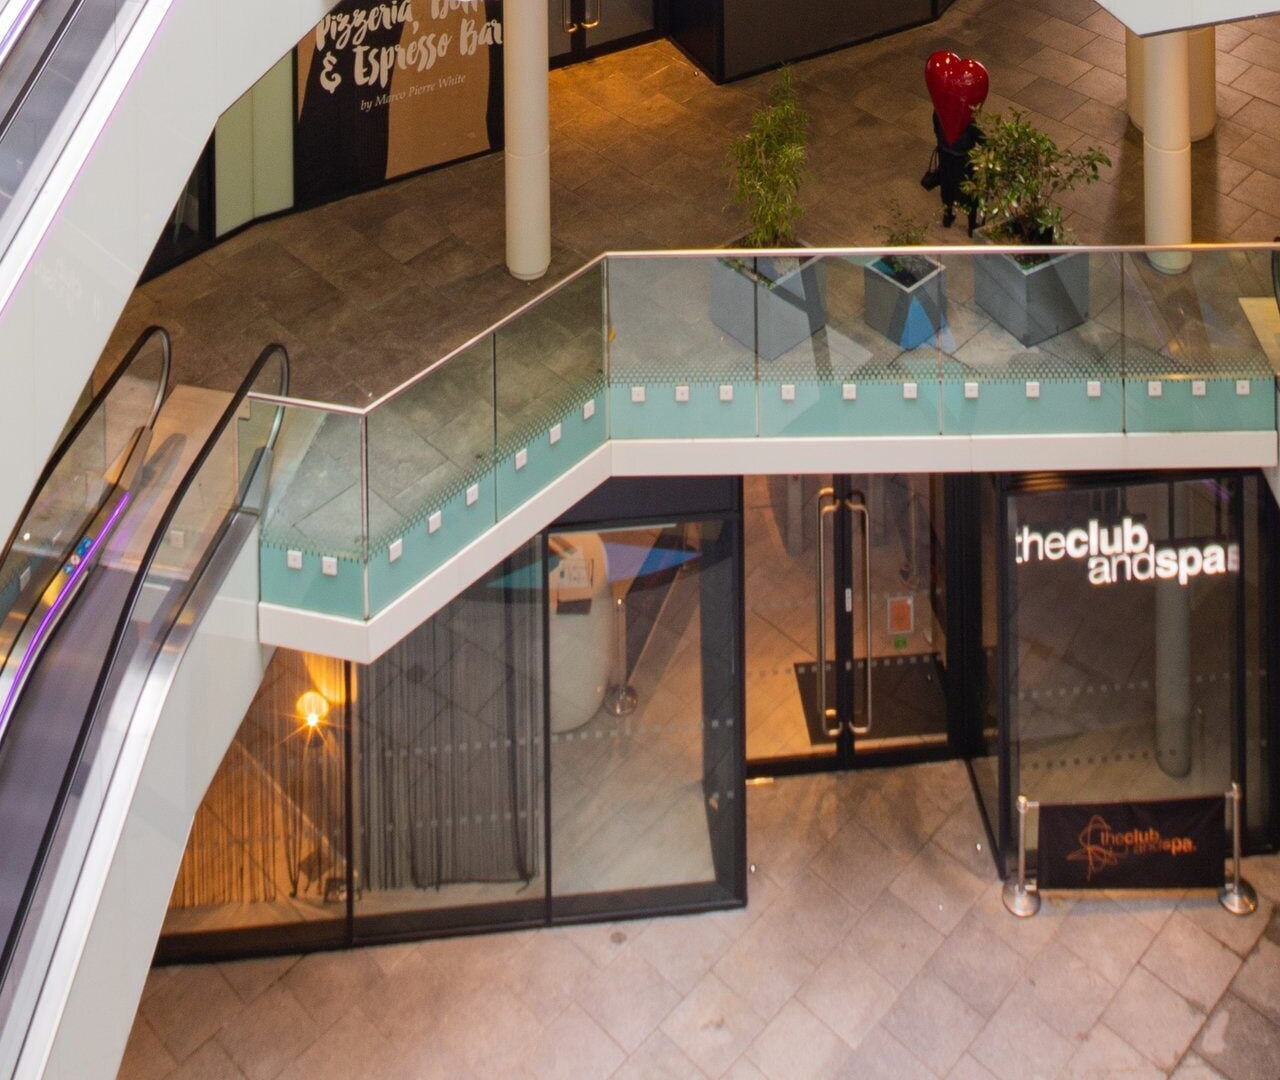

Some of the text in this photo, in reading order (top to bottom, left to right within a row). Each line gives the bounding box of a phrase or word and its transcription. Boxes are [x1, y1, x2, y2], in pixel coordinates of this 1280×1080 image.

[320, 19, 503, 94] & Espresso Bar
[360, 73, 466, 112] by Marco Pierre White
